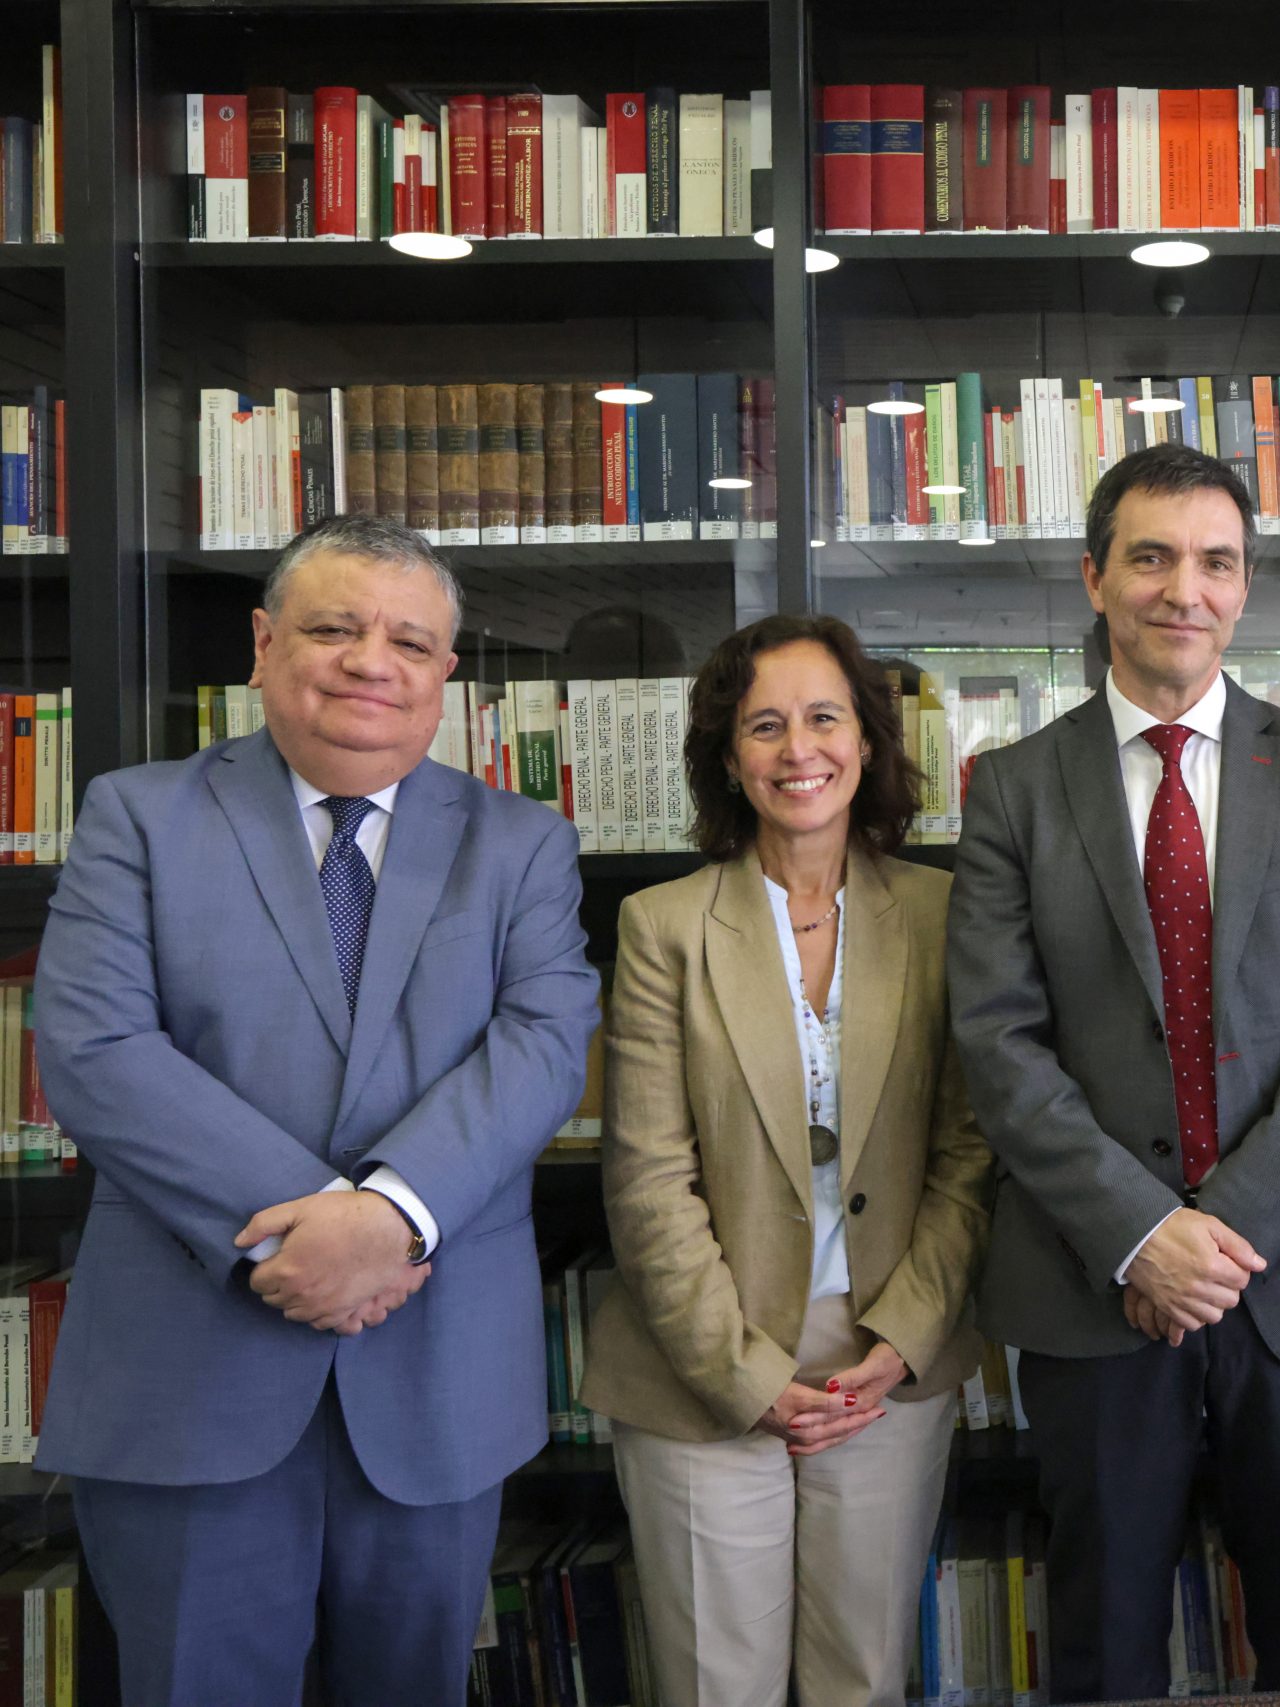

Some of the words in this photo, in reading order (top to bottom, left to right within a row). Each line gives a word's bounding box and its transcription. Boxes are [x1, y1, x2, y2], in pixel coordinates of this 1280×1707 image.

[651, 104, 659, 129] PENAL
[935, 122, 949, 141] PENAL
[651, 130, 659, 169] DERECHO
[935, 142, 949, 168] CODIGO
[651, 170, 659, 182] DE
[935, 168, 949, 177] AL
[651, 183, 659, 222] ESTUDIOS
[935, 177, 949, 222] COMENTARIOS
[606, 437, 614, 446] AL
[614, 432, 622, 453] PENAL
[932, 434, 939, 442] DE
[606, 447, 614, 499] INTRODUCCION
[614, 454, 622, 481] CODIGO
[614, 482, 622, 505] NUEVO
[574, 696, 588, 728] GENERAL
[596, 693, 611, 726] GENERAL
[621, 713, 635, 743] GENERAL
[643, 709, 657, 739] GENERAL
[664, 710, 678, 740] GENERAL
[576, 729, 589, 751] PARTE
[599, 727, 612, 749] PARTE
[527, 749, 534, 758] DE
[533, 741, 542, 762] PENAL
[623, 744, 635, 765] PARTE
[646, 740, 658, 761] PARTE
[667, 741, 679, 762] PARTE
[577, 755, 591, 778] PENAL
[600, 753, 613, 775] PENAL
[647, 764, 659, 784] PENAL
[533, 763, 542, 791] DERECHO
[624, 768, 637, 790] PENAL
[668, 766, 680, 786] PENAL
[579, 779, 592, 813] DERECHO
[602, 776, 615, 810] DERECHO
[648, 784, 660, 818] DERECHO
[669, 787, 681, 819] DERECHO
[625, 790, 638, 822] DERECHO
